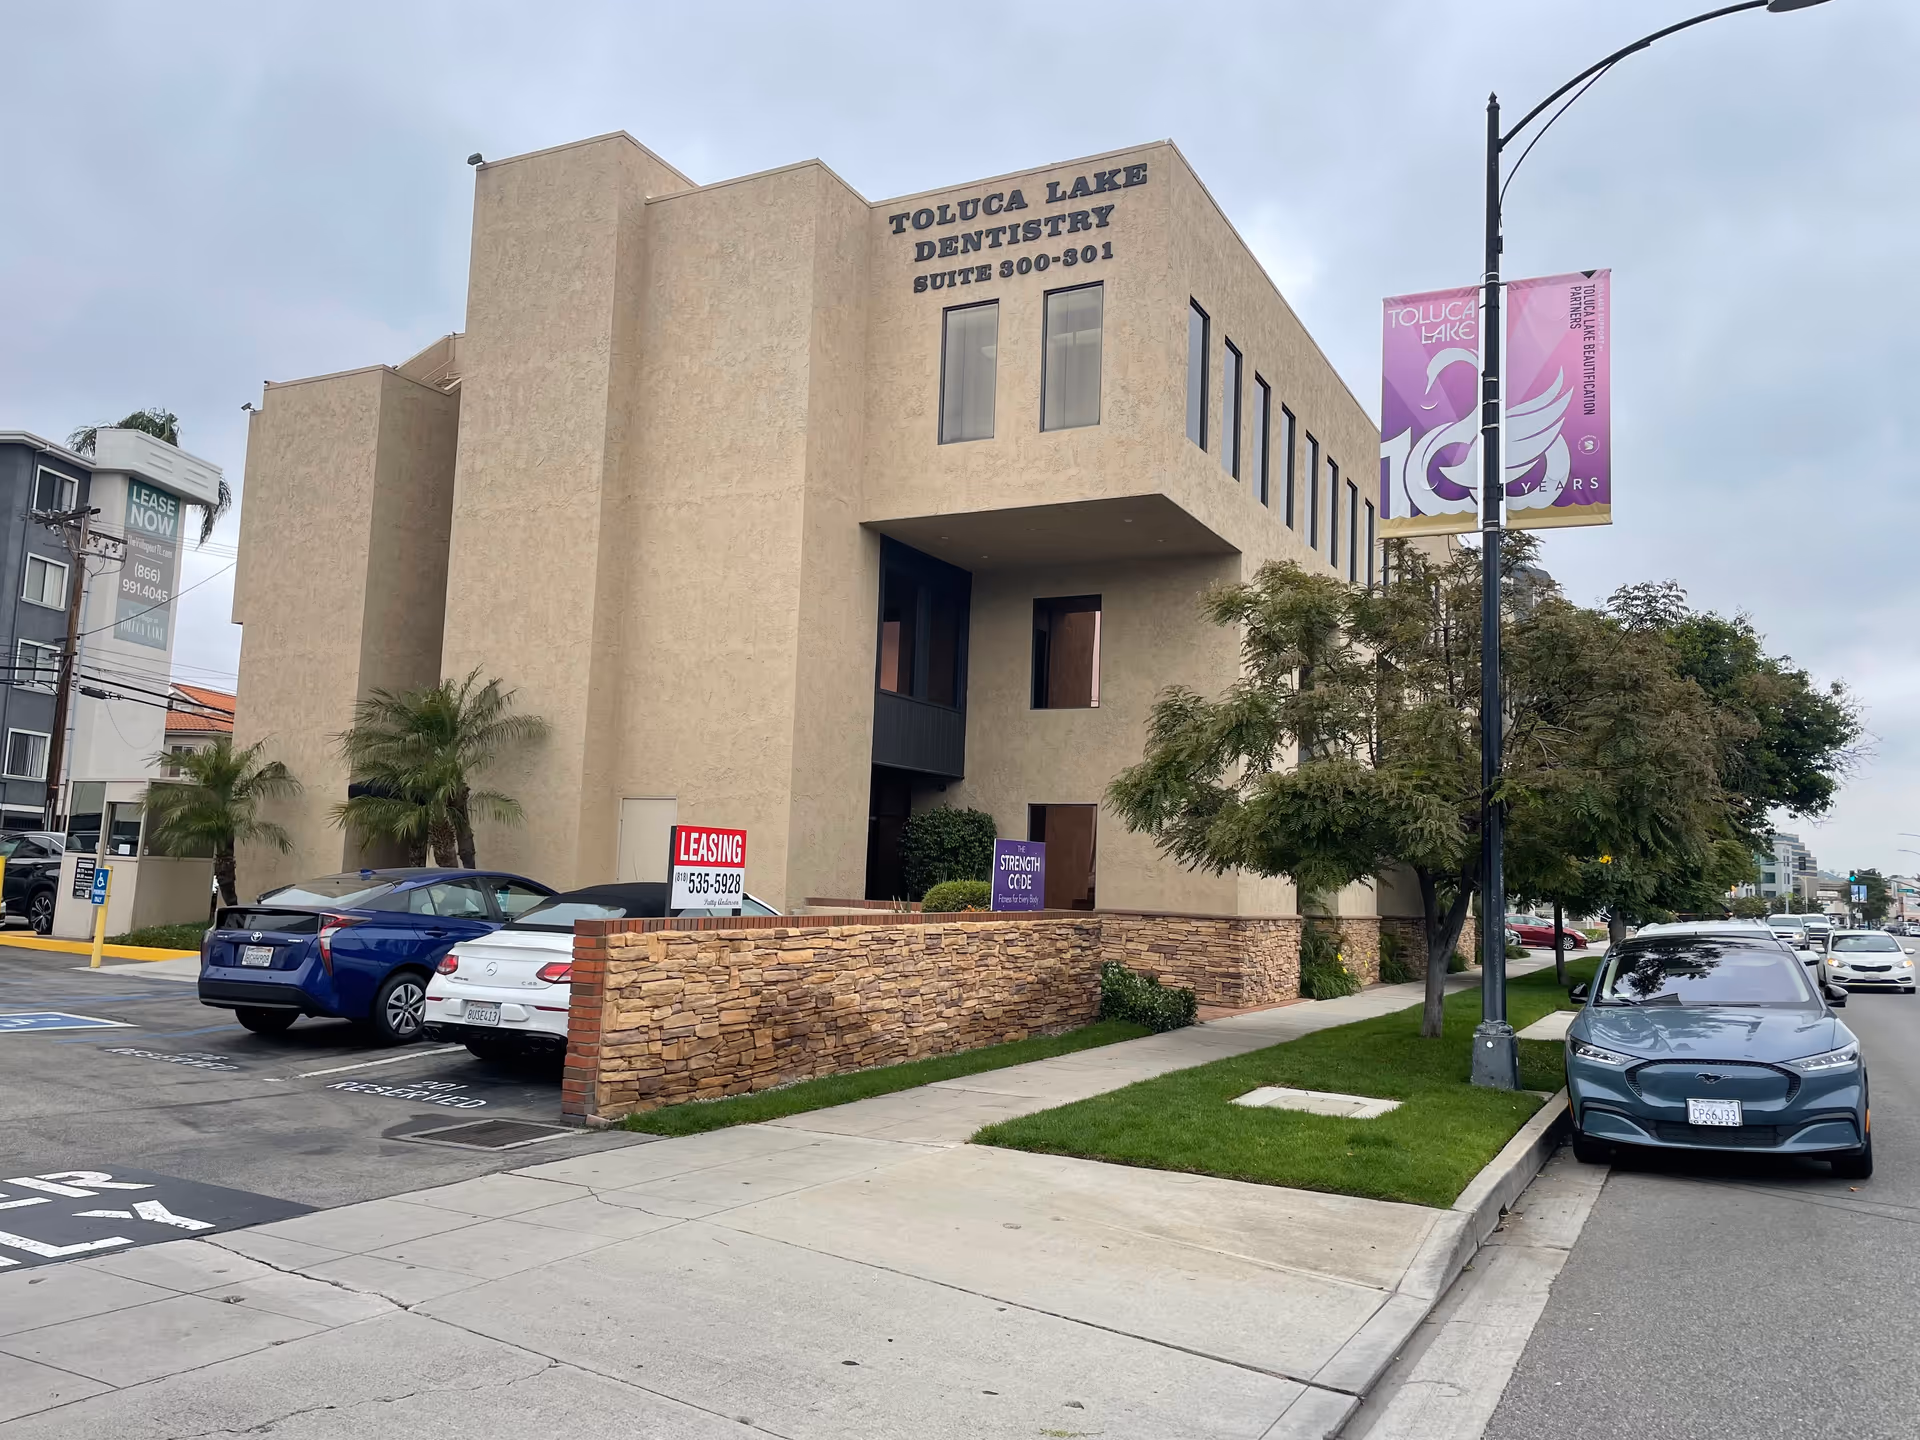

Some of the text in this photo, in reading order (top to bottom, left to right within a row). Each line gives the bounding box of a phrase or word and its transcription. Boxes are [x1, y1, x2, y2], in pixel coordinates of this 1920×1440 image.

[889, 163, 1148, 234] TOLUCA LAKE
[914, 204, 1115, 262] DENTISTRY
[913, 242, 1114, 293] SUITE 300-301
[1569, 286, 1582, 329] PARTNERS
[1387, 299, 1475, 345] TOLUCA LAKE
[1583, 284, 1596, 415] TOLUCA LAKE BEAUTIFICATION
[1521, 477, 1599, 493] YEARS
[132, 485, 176, 516] LEASE
[130, 504, 174, 537] NOW
[134, 562, 161, 584] (866)
[122, 579, 168, 603] 991.4045
[680, 831, 743, 863] LEASING
[1017, 845, 1026, 853] THE
[1000, 854, 1041, 872] STRENGTH
[675, 872, 741, 895] (818) 535-5928
[1008, 873, 1032, 890] CODE
[998, 893, 1012, 903] Fitness
[1019, 894, 1028, 905] Every
[1029, 894, 1039, 905] Body
[467, 1009, 498, 1022] 8USE413
[326, 1081, 487, 1109] RESERVED
[408, 1080, 469, 1092] 201
[1692, 1108, 1737, 1121] CP66J33
